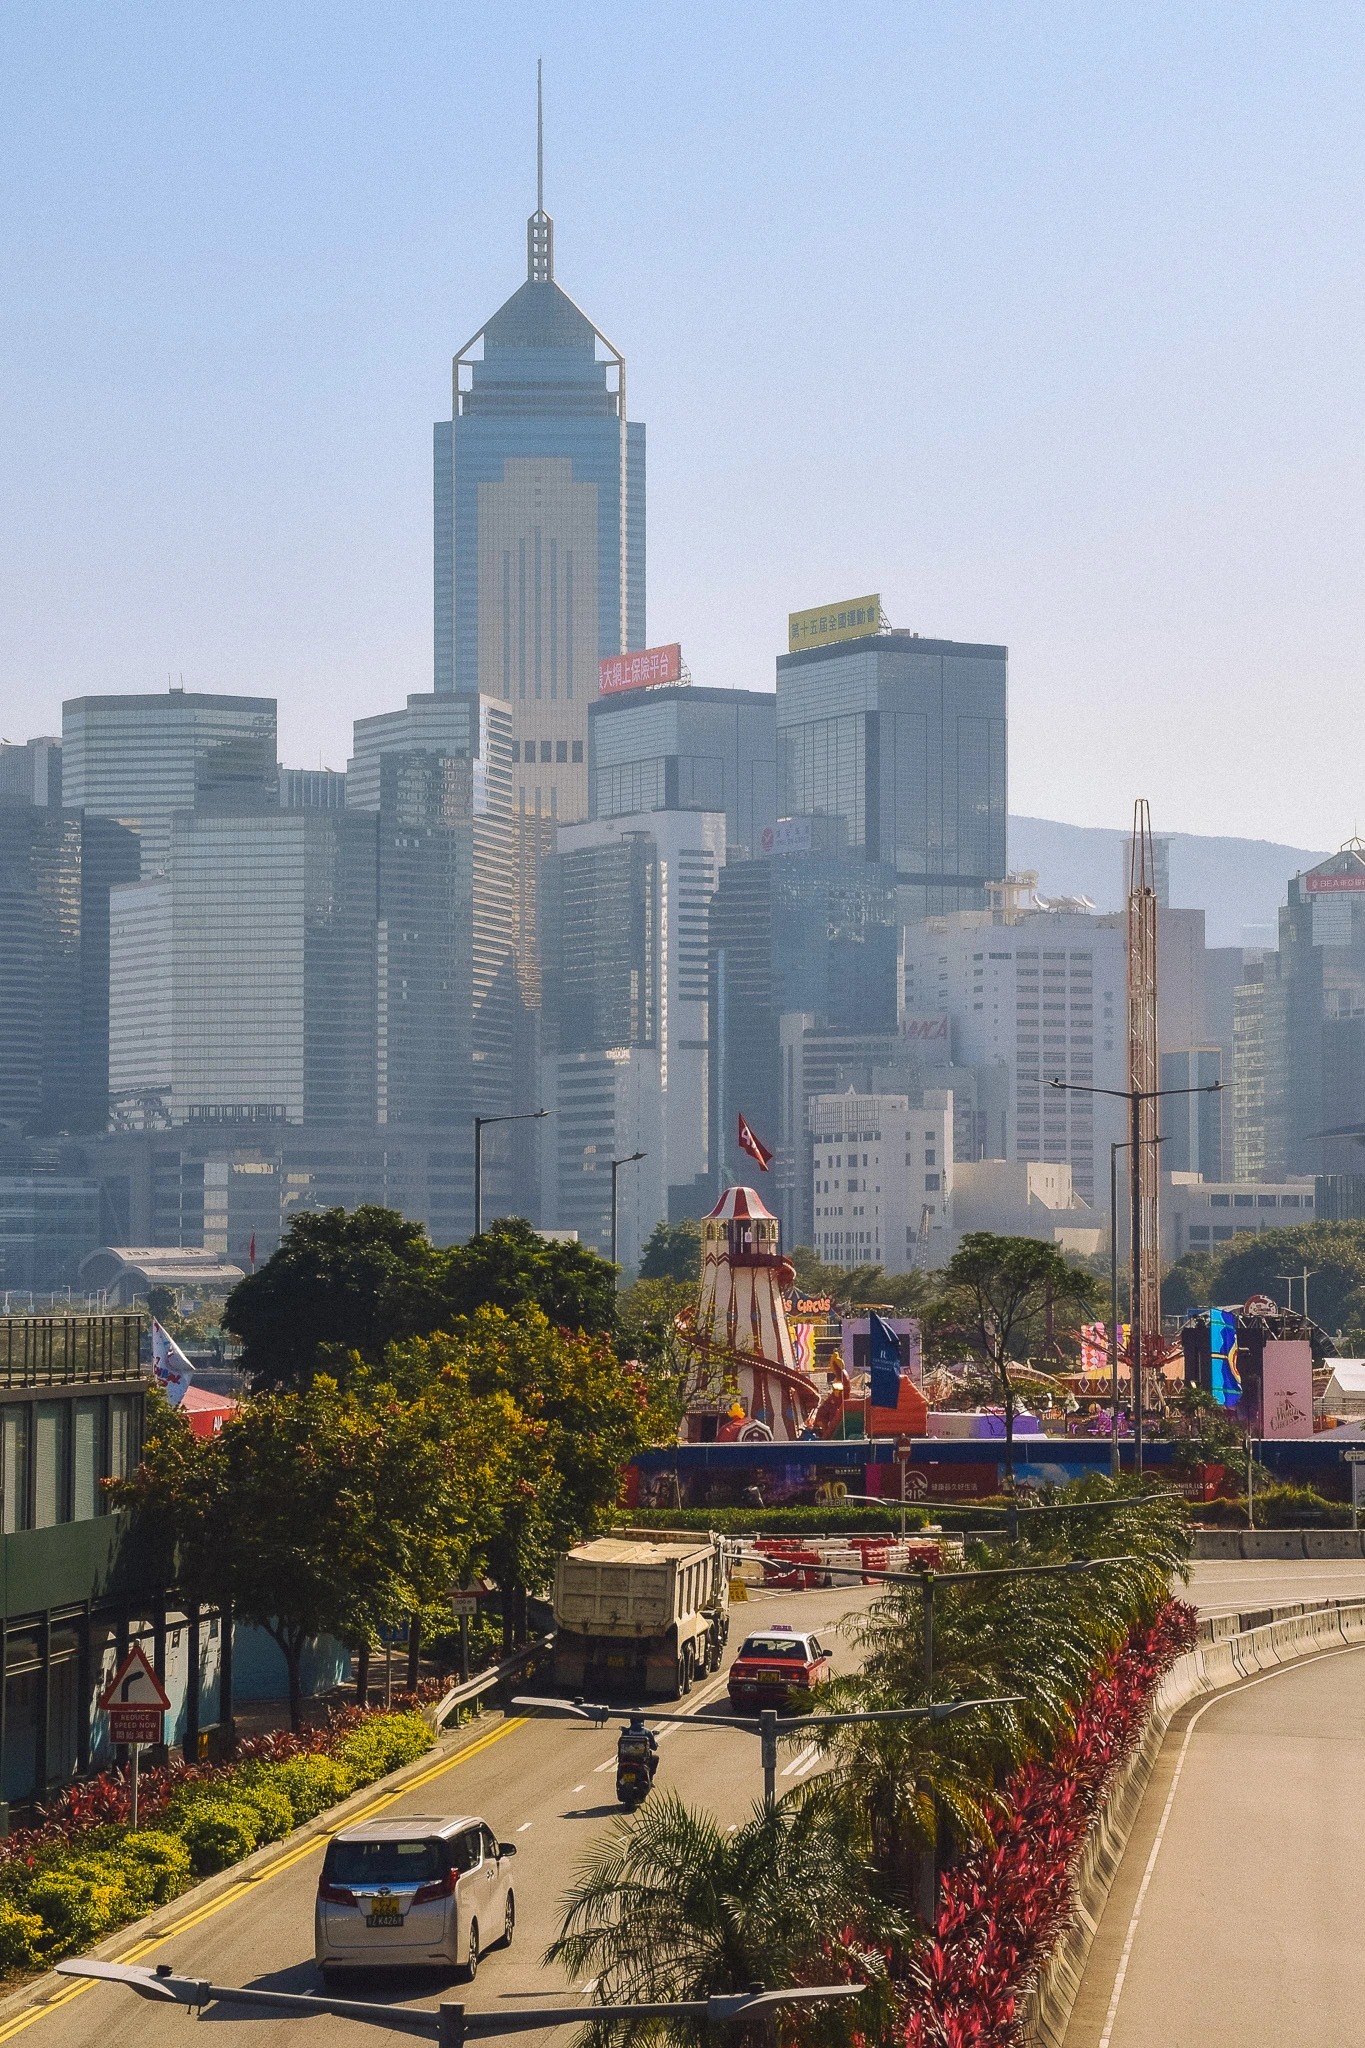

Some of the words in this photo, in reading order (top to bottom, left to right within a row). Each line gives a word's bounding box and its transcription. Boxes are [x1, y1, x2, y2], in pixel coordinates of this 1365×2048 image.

[792, 606, 875, 640] 第十五屆全國運動會
[797, 1298, 831, 1313] CIRCUS
[905, 1489, 926, 1499] AIA
